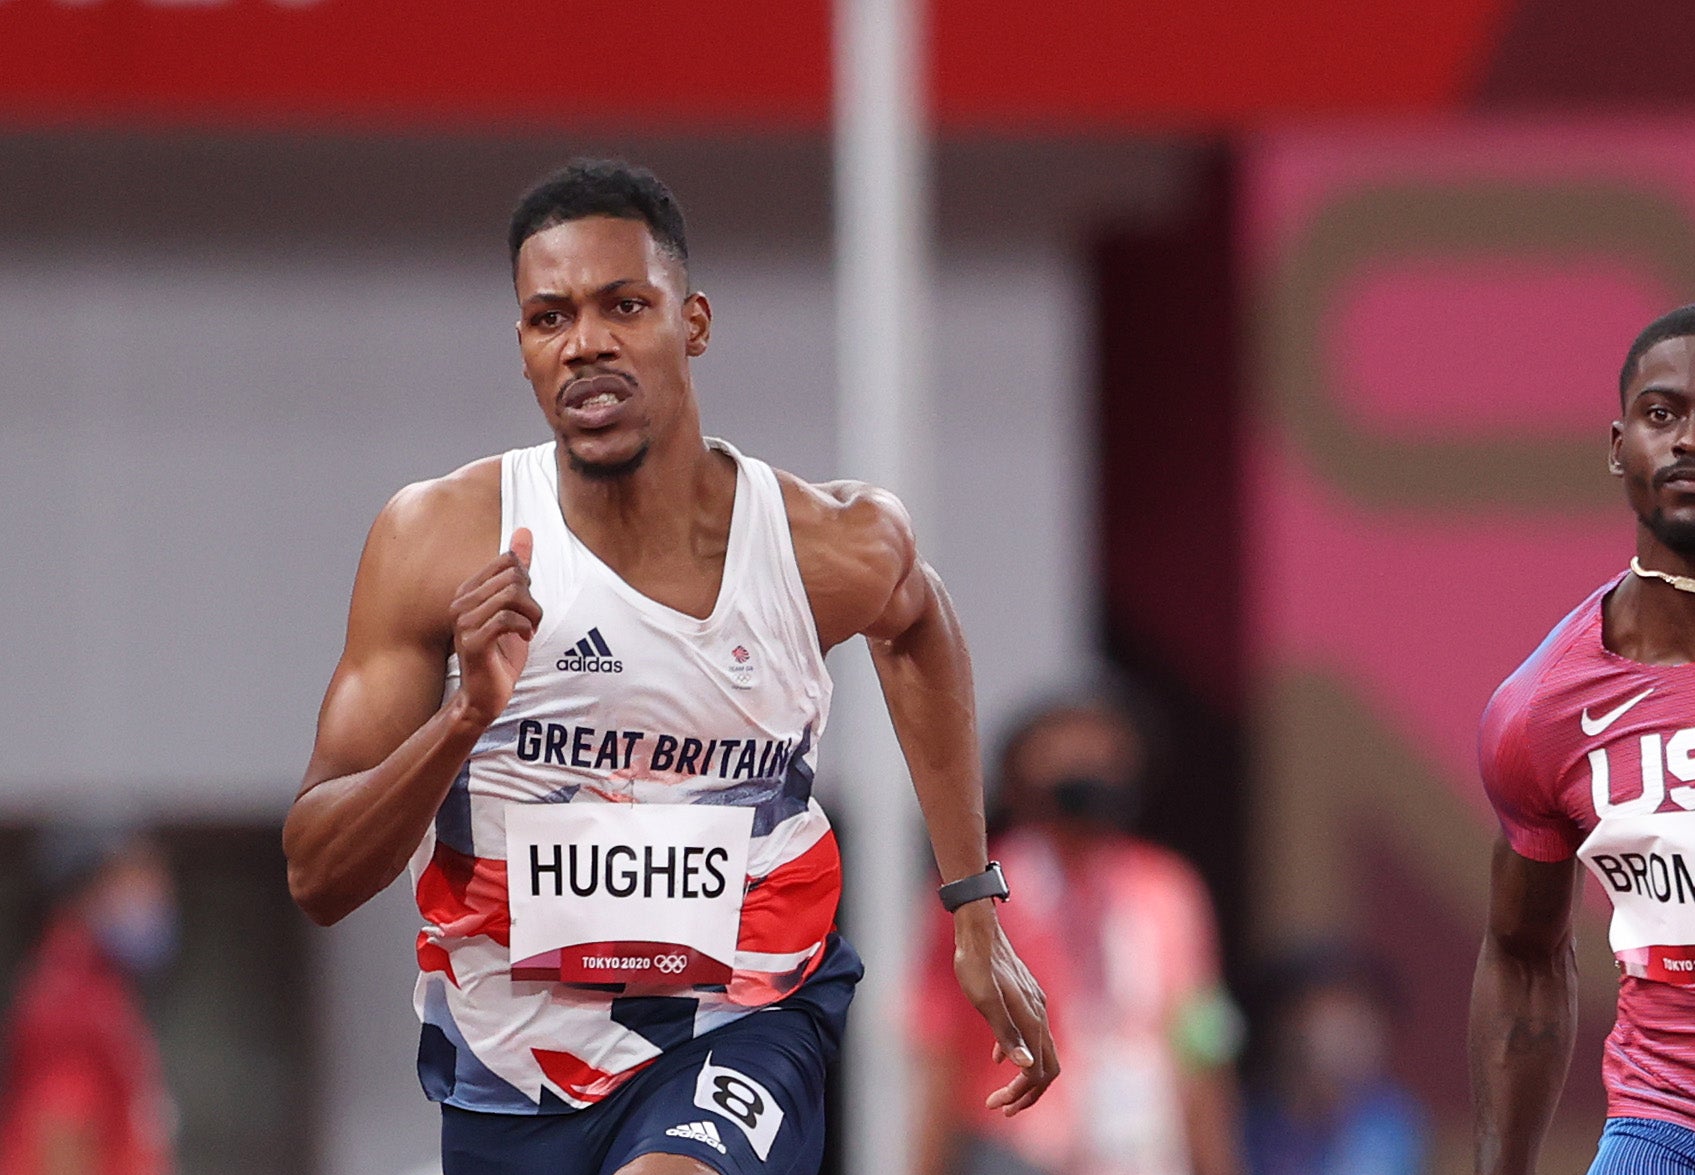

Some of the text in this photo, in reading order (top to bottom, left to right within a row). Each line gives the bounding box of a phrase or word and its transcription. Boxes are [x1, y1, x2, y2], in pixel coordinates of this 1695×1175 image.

[556, 656, 623, 673] adidas
[517, 720, 791, 780] GREAT BRITAIN
[529, 844, 729, 899] HUGHES
[582, 956, 651, 969] TOKYO 2020
[1662, 957, 1694, 971] TOKYO
[712, 1075, 764, 1130] 8
